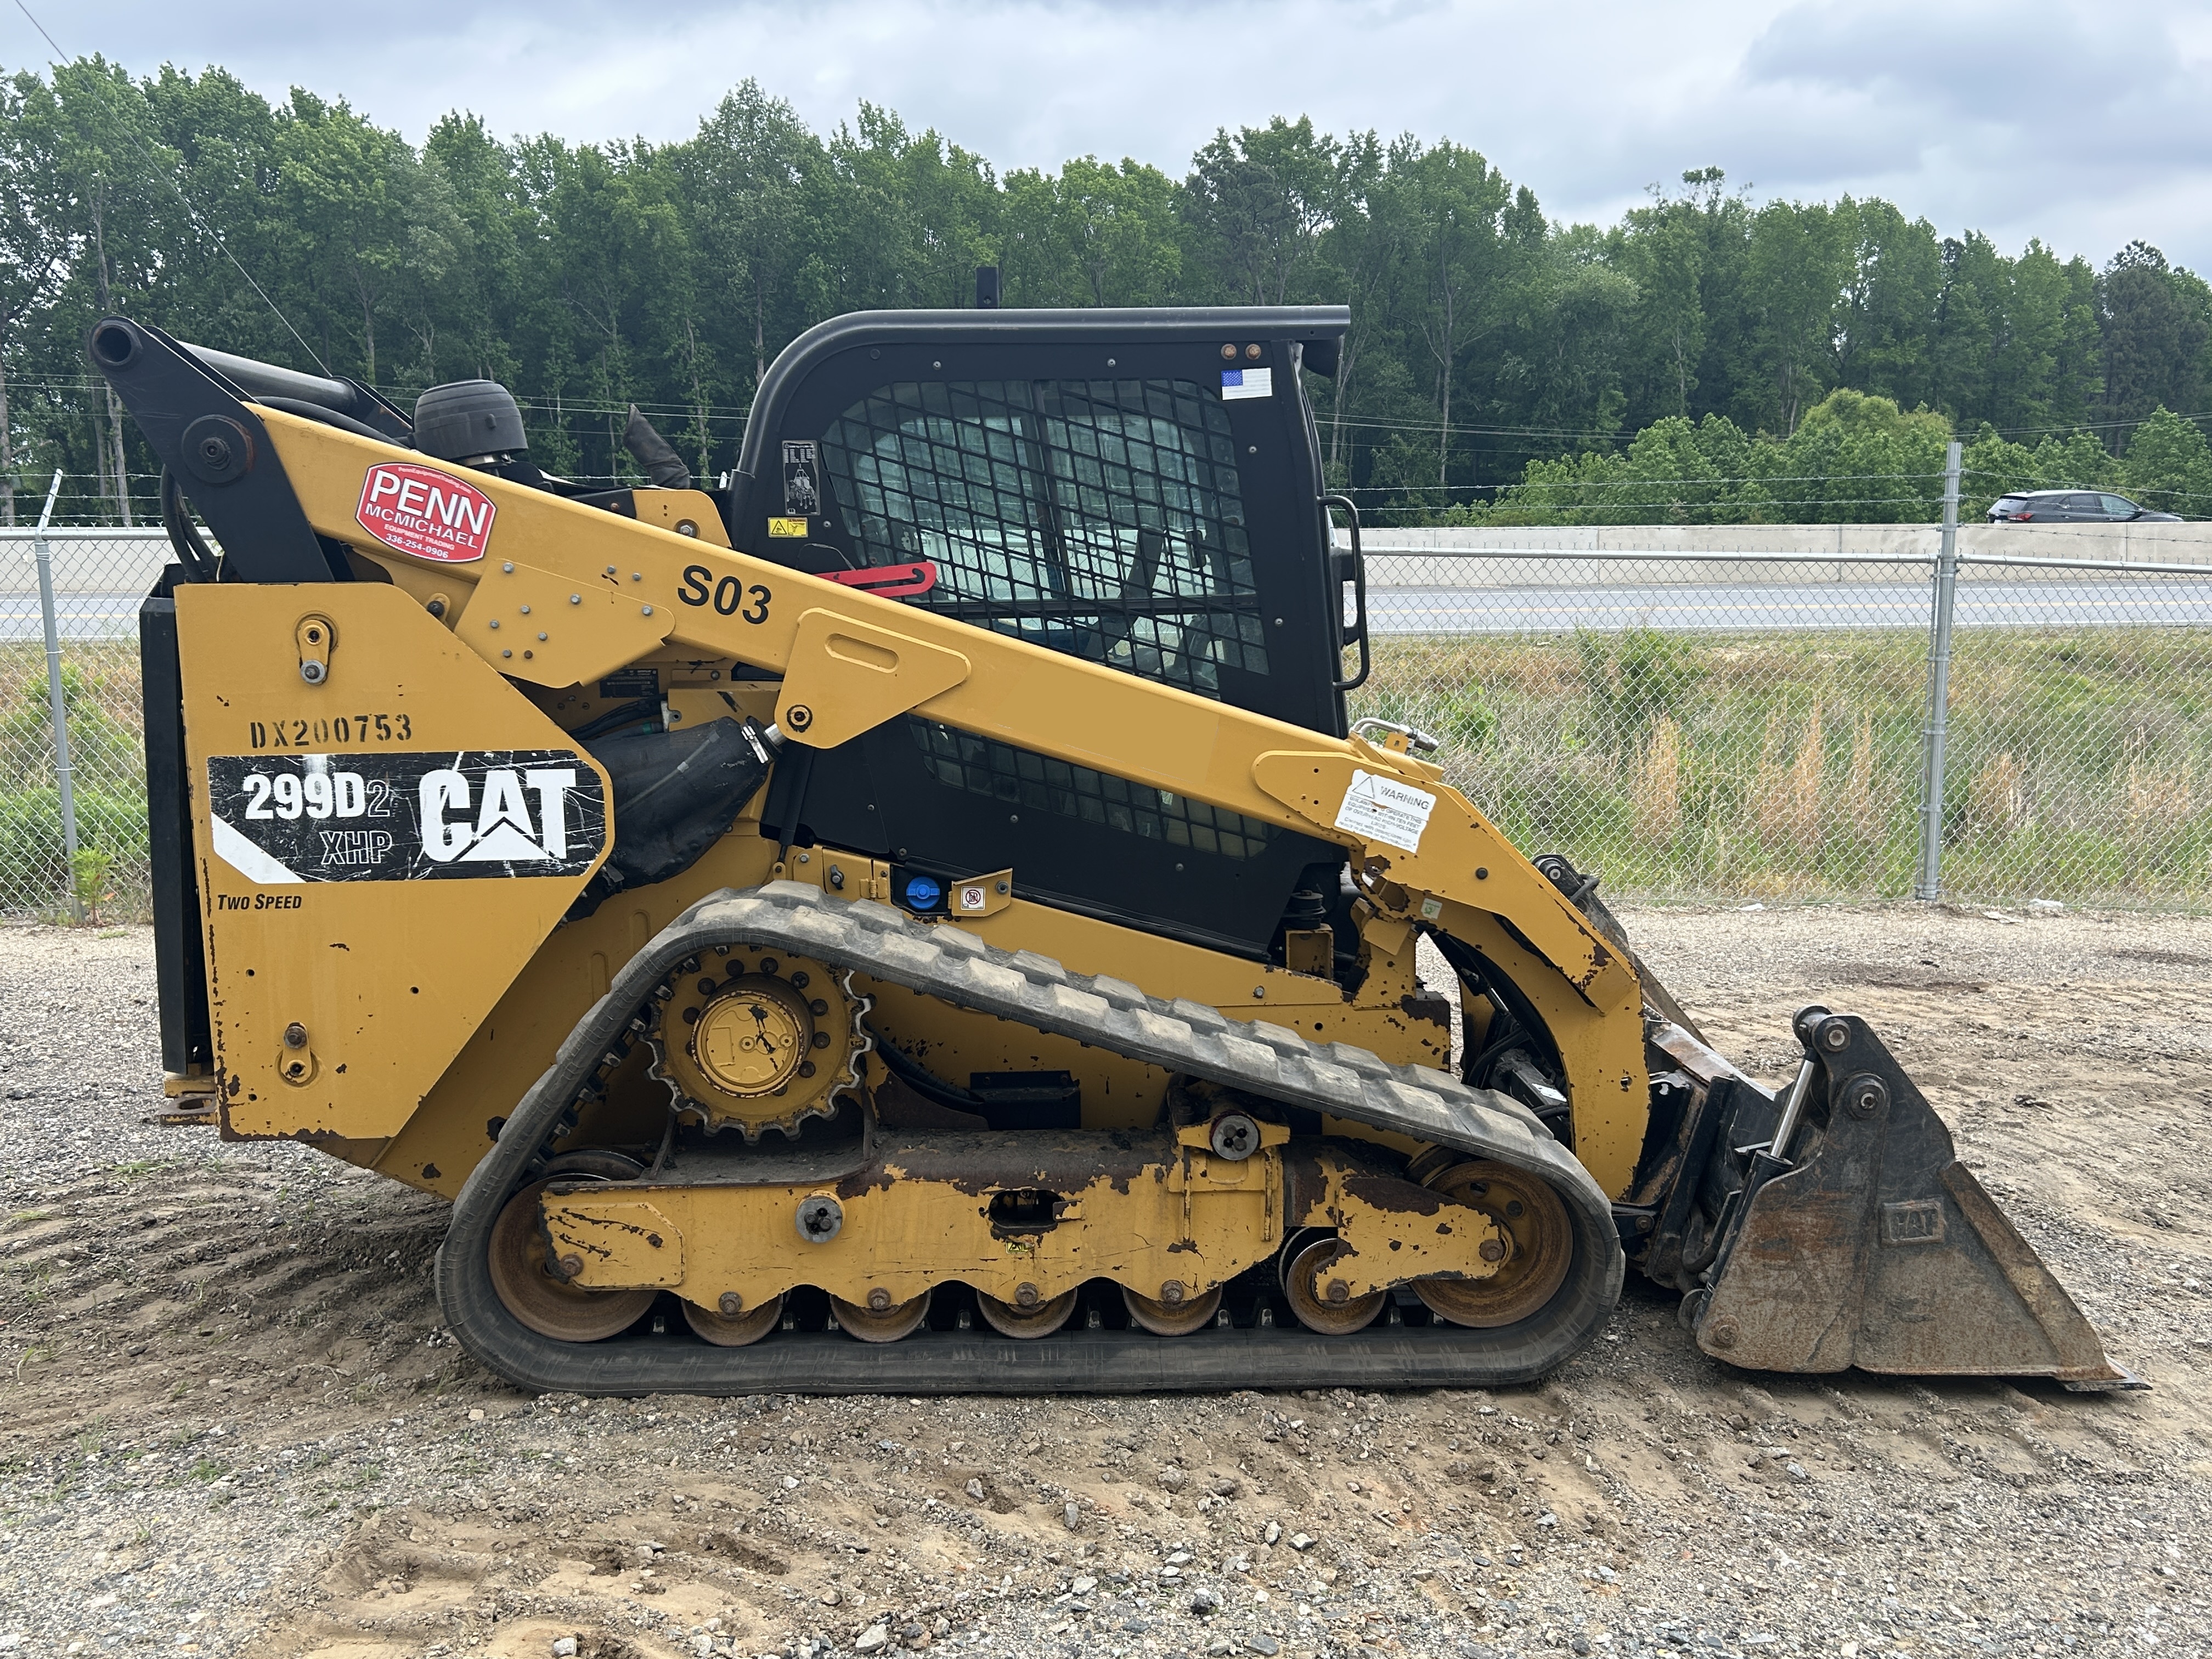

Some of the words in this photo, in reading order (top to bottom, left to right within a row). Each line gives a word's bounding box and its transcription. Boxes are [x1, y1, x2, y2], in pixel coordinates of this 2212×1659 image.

[369, 470, 488, 535] PENN
[365, 503, 478, 549] MCMICHAEL
[384, 523, 425, 541] EQUIPMENT
[425, 534, 455, 551] TRADING
[386, 533, 449, 559] 336-254-0906
[678, 565, 771, 624] S03
[250, 713, 412, 749] DX200753
[242, 771, 391, 820] 299D2
[1347, 801, 1376, 813] EQUIPME
[1380, 786, 1429, 810] WARNING
[419, 768, 577, 863] CAT
[319, 830, 393, 866] XHP
[217, 894, 250, 911] TWO
[254, 893, 302, 910] SPEED
